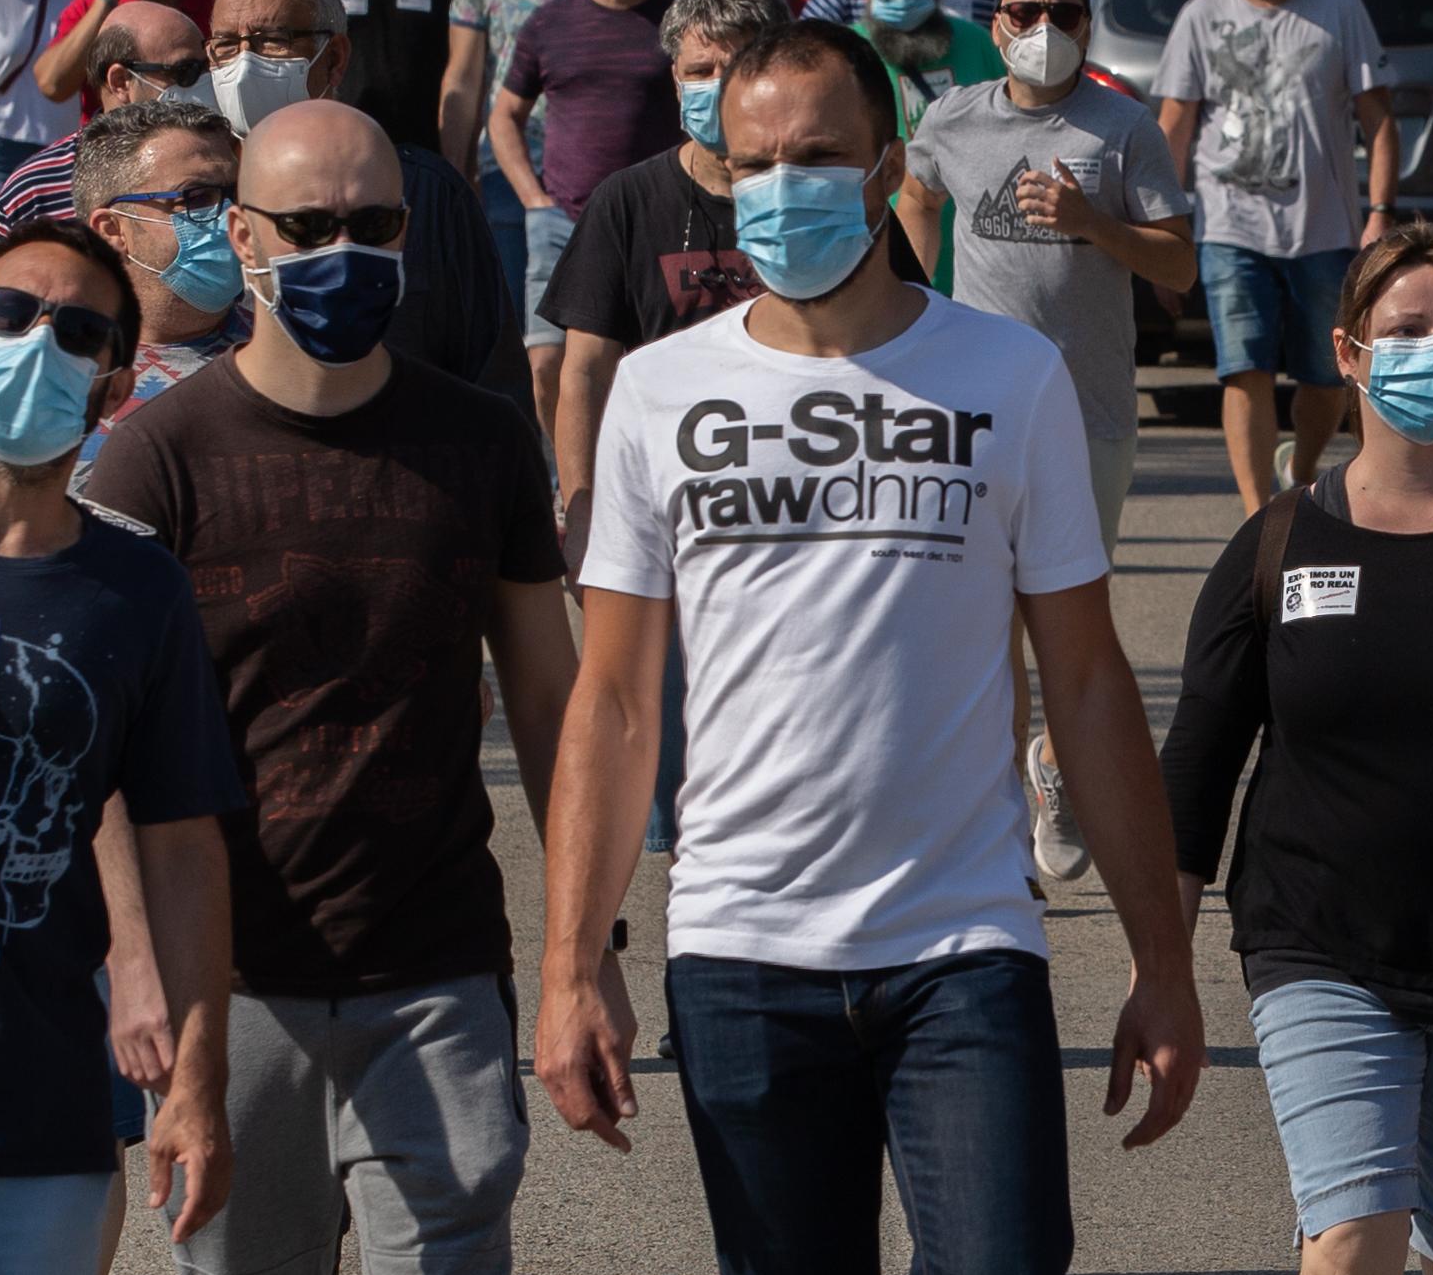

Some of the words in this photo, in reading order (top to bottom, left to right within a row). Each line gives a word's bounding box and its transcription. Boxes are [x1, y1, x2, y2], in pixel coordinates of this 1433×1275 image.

[979, 212, 1011, 238] 1966
[676, 390, 993, 473] G-Star
[1339, 571, 1355, 579] UN
[1327, 580, 1355, 589] REAL
